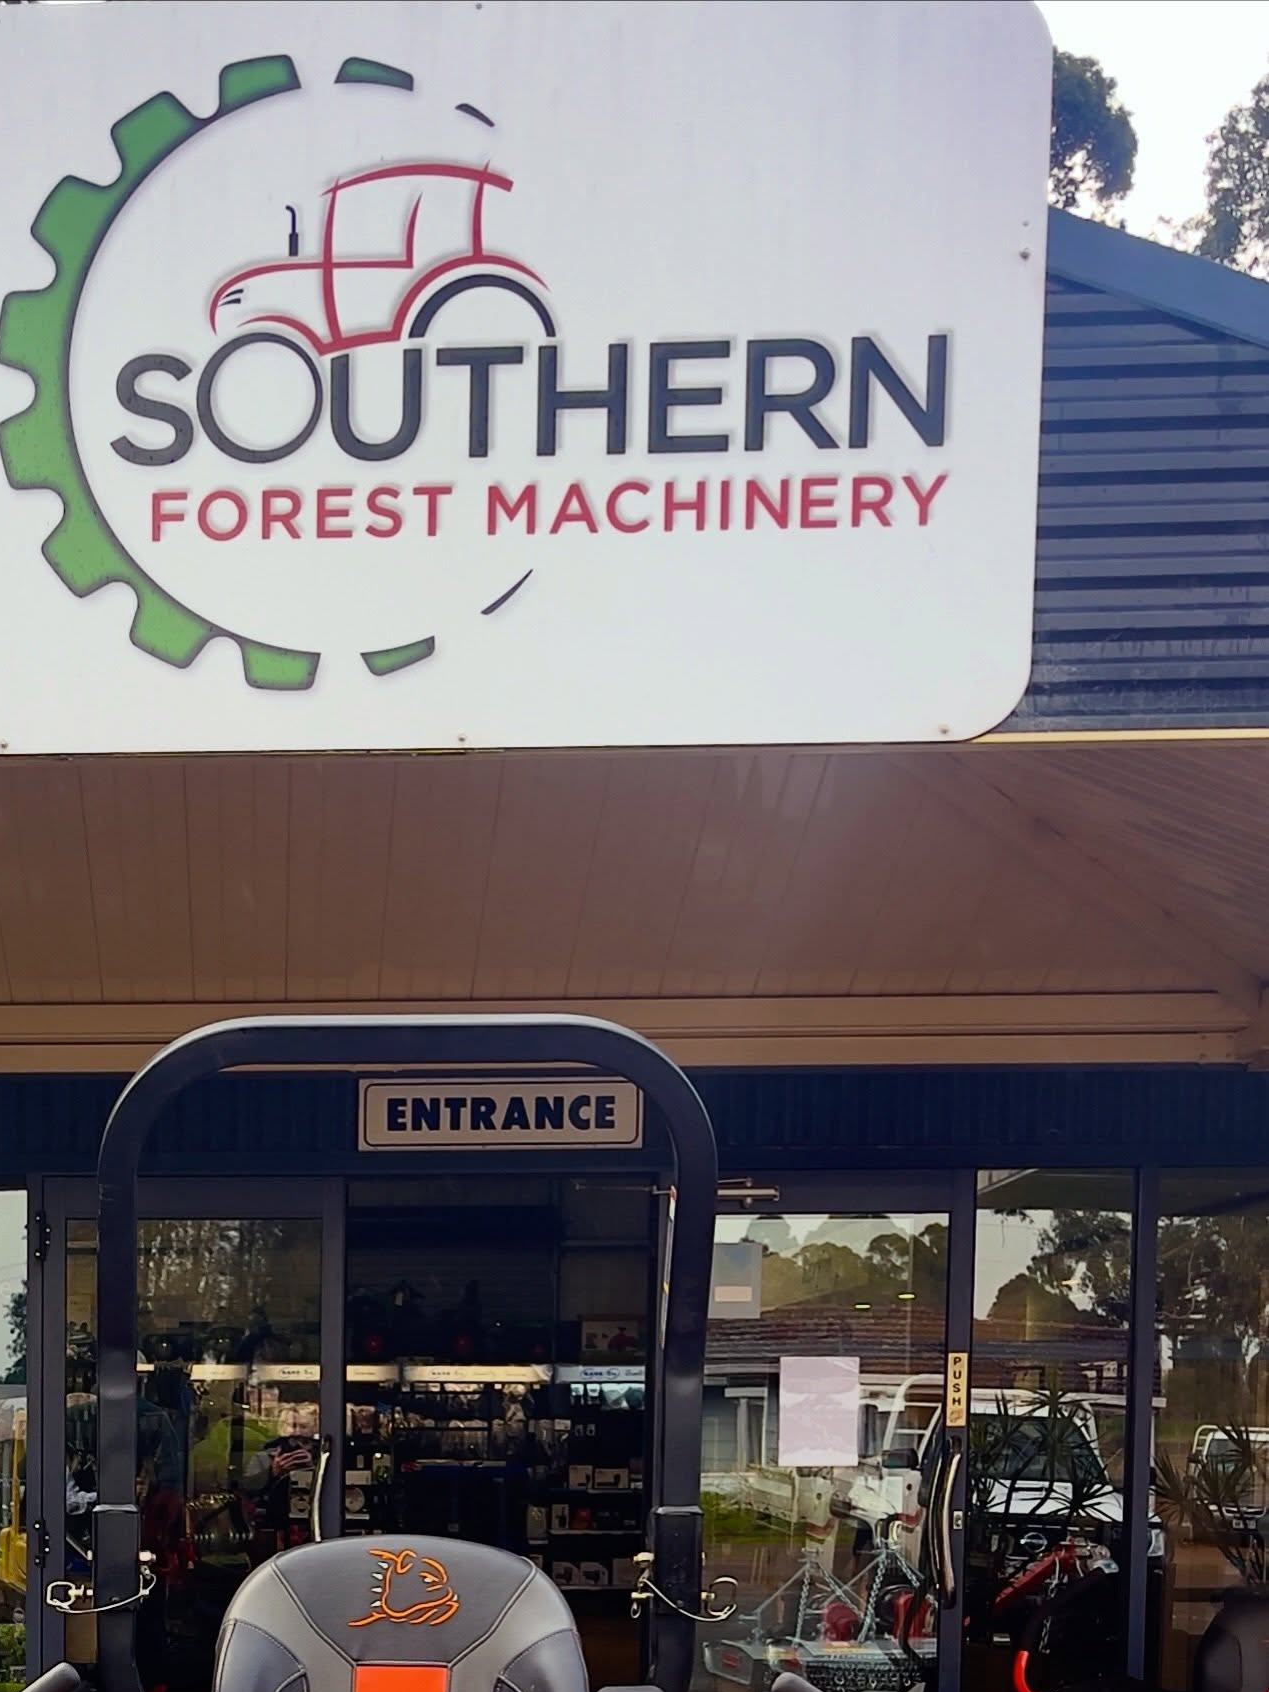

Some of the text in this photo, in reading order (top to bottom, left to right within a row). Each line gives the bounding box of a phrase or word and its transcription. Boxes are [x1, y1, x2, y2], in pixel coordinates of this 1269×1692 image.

[110, 331, 949, 466] SOUTHERN
[150, 473, 948, 542] FOREST MACHINERY
[386, 1094, 616, 1132] ENTRANCE
[952, 1356, 962, 1406] PUSH
